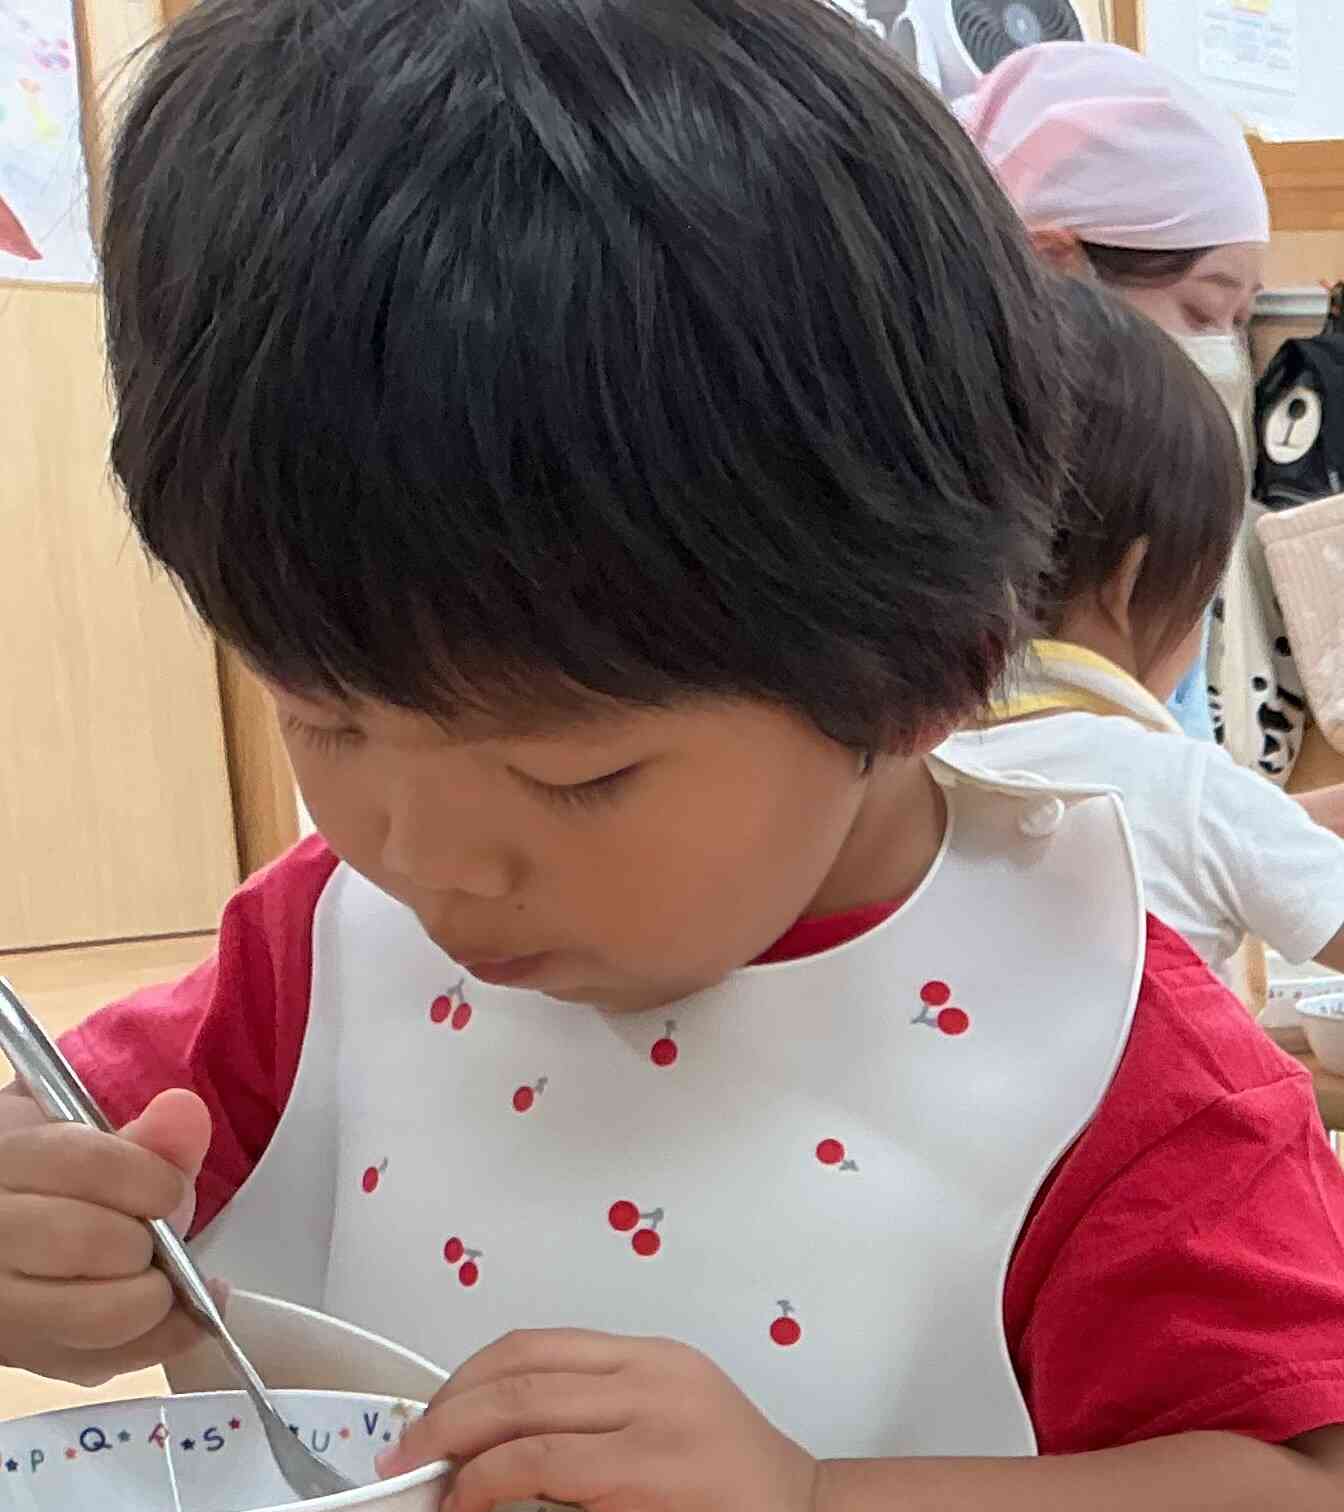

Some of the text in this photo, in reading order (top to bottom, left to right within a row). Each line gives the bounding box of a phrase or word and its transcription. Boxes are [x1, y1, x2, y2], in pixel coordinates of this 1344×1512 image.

[31, 1448, 45, 1473] P
[79, 1425, 113, 1452] Q
[202, 1427, 225, 1452] S
[312, 1431, 331, 1453] U
[363, 1411, 379, 1436] V
